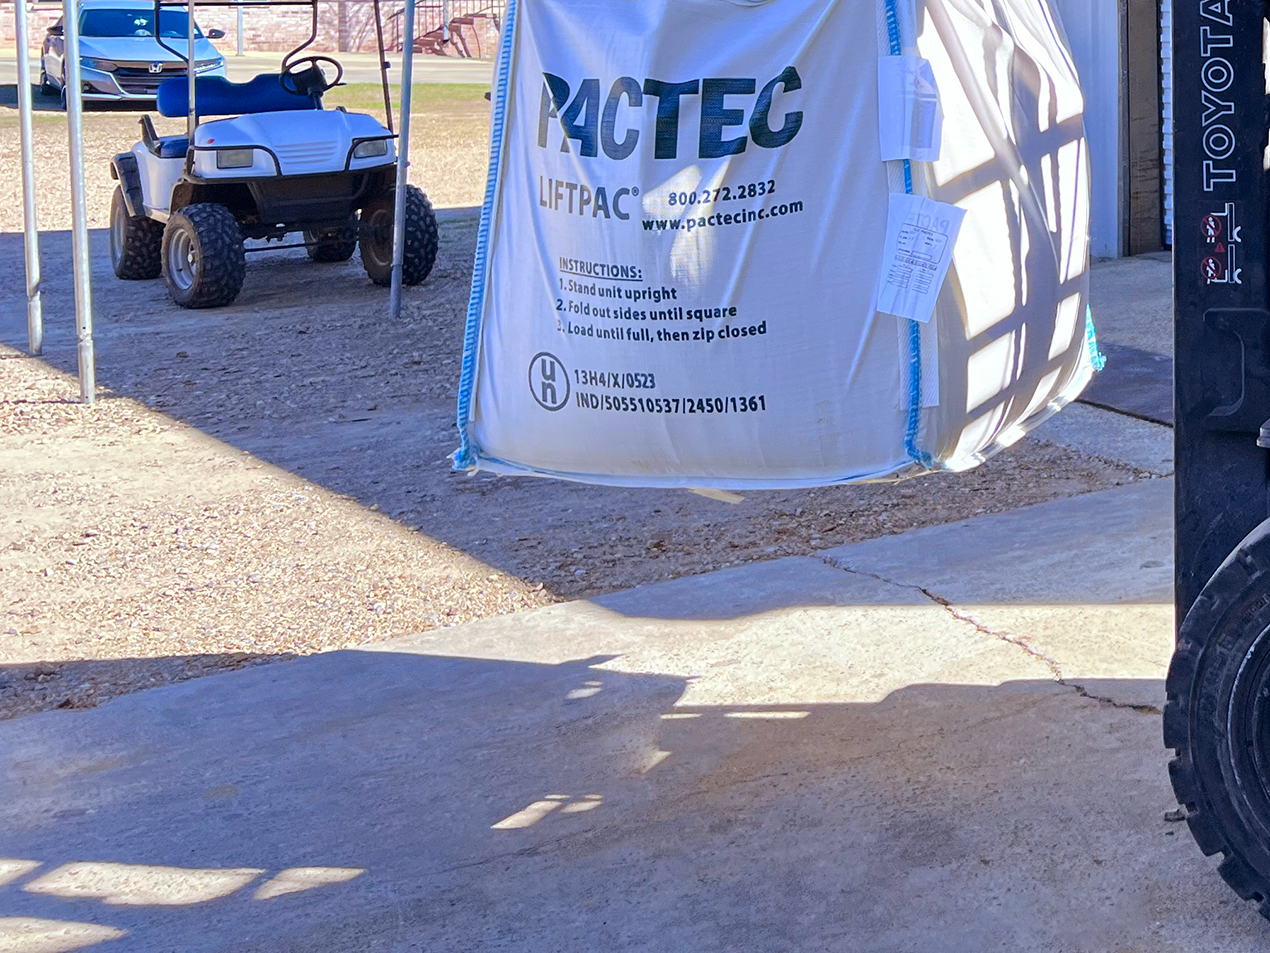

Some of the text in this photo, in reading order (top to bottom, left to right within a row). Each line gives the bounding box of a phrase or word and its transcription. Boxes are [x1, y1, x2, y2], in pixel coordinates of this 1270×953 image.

[537, 66, 804, 160] PACTEC
[668, 179, 777, 206] 800.272.2832
[642, 200, 804, 232] www.pactecinc.com
[559, 256, 643, 280] INSTRUCTIONS:
[559, 278, 677, 303] 1. Stand unit upright
[556, 298, 738, 322] 2. Fold out sides until square
[557, 319, 767, 343] 3. Load until full, then zip closed
[574, 369, 656, 389] 13H4/X/0523
[576, 392, 766, 414] IND/505510537/2450/1361
